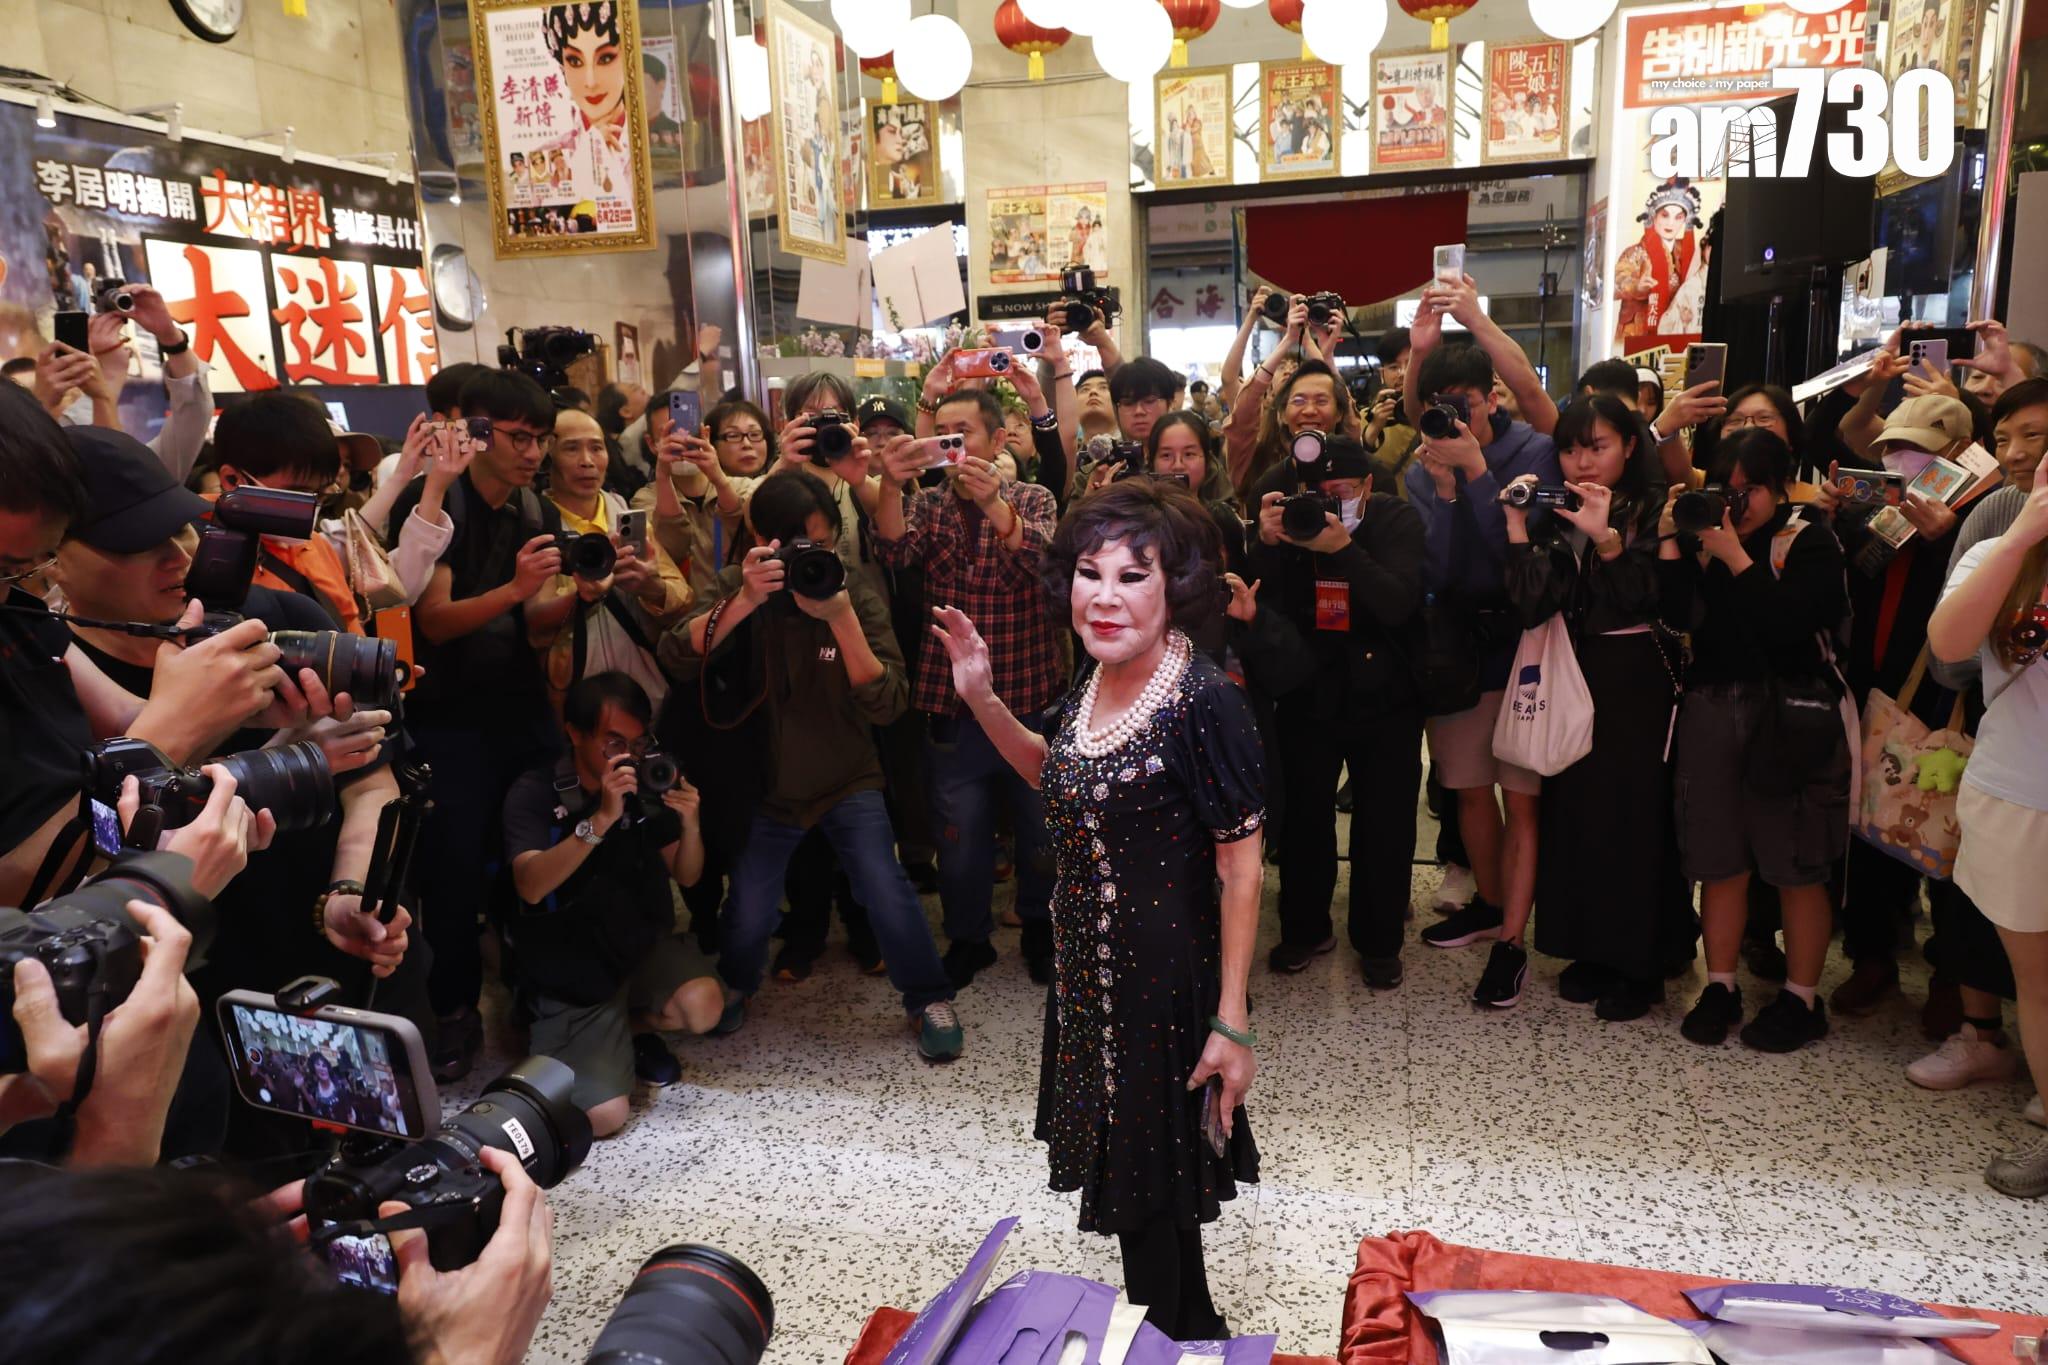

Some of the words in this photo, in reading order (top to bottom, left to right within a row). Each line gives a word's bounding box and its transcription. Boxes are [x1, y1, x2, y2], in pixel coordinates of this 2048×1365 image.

[500, 73, 563, 105] 李清照
[36, 159, 198, 222] 李居明揭開
[200, 167, 332, 253] 大結界
[332, 206, 422, 252] 到底是什
[1004, 303, 1033, 313] NOW
